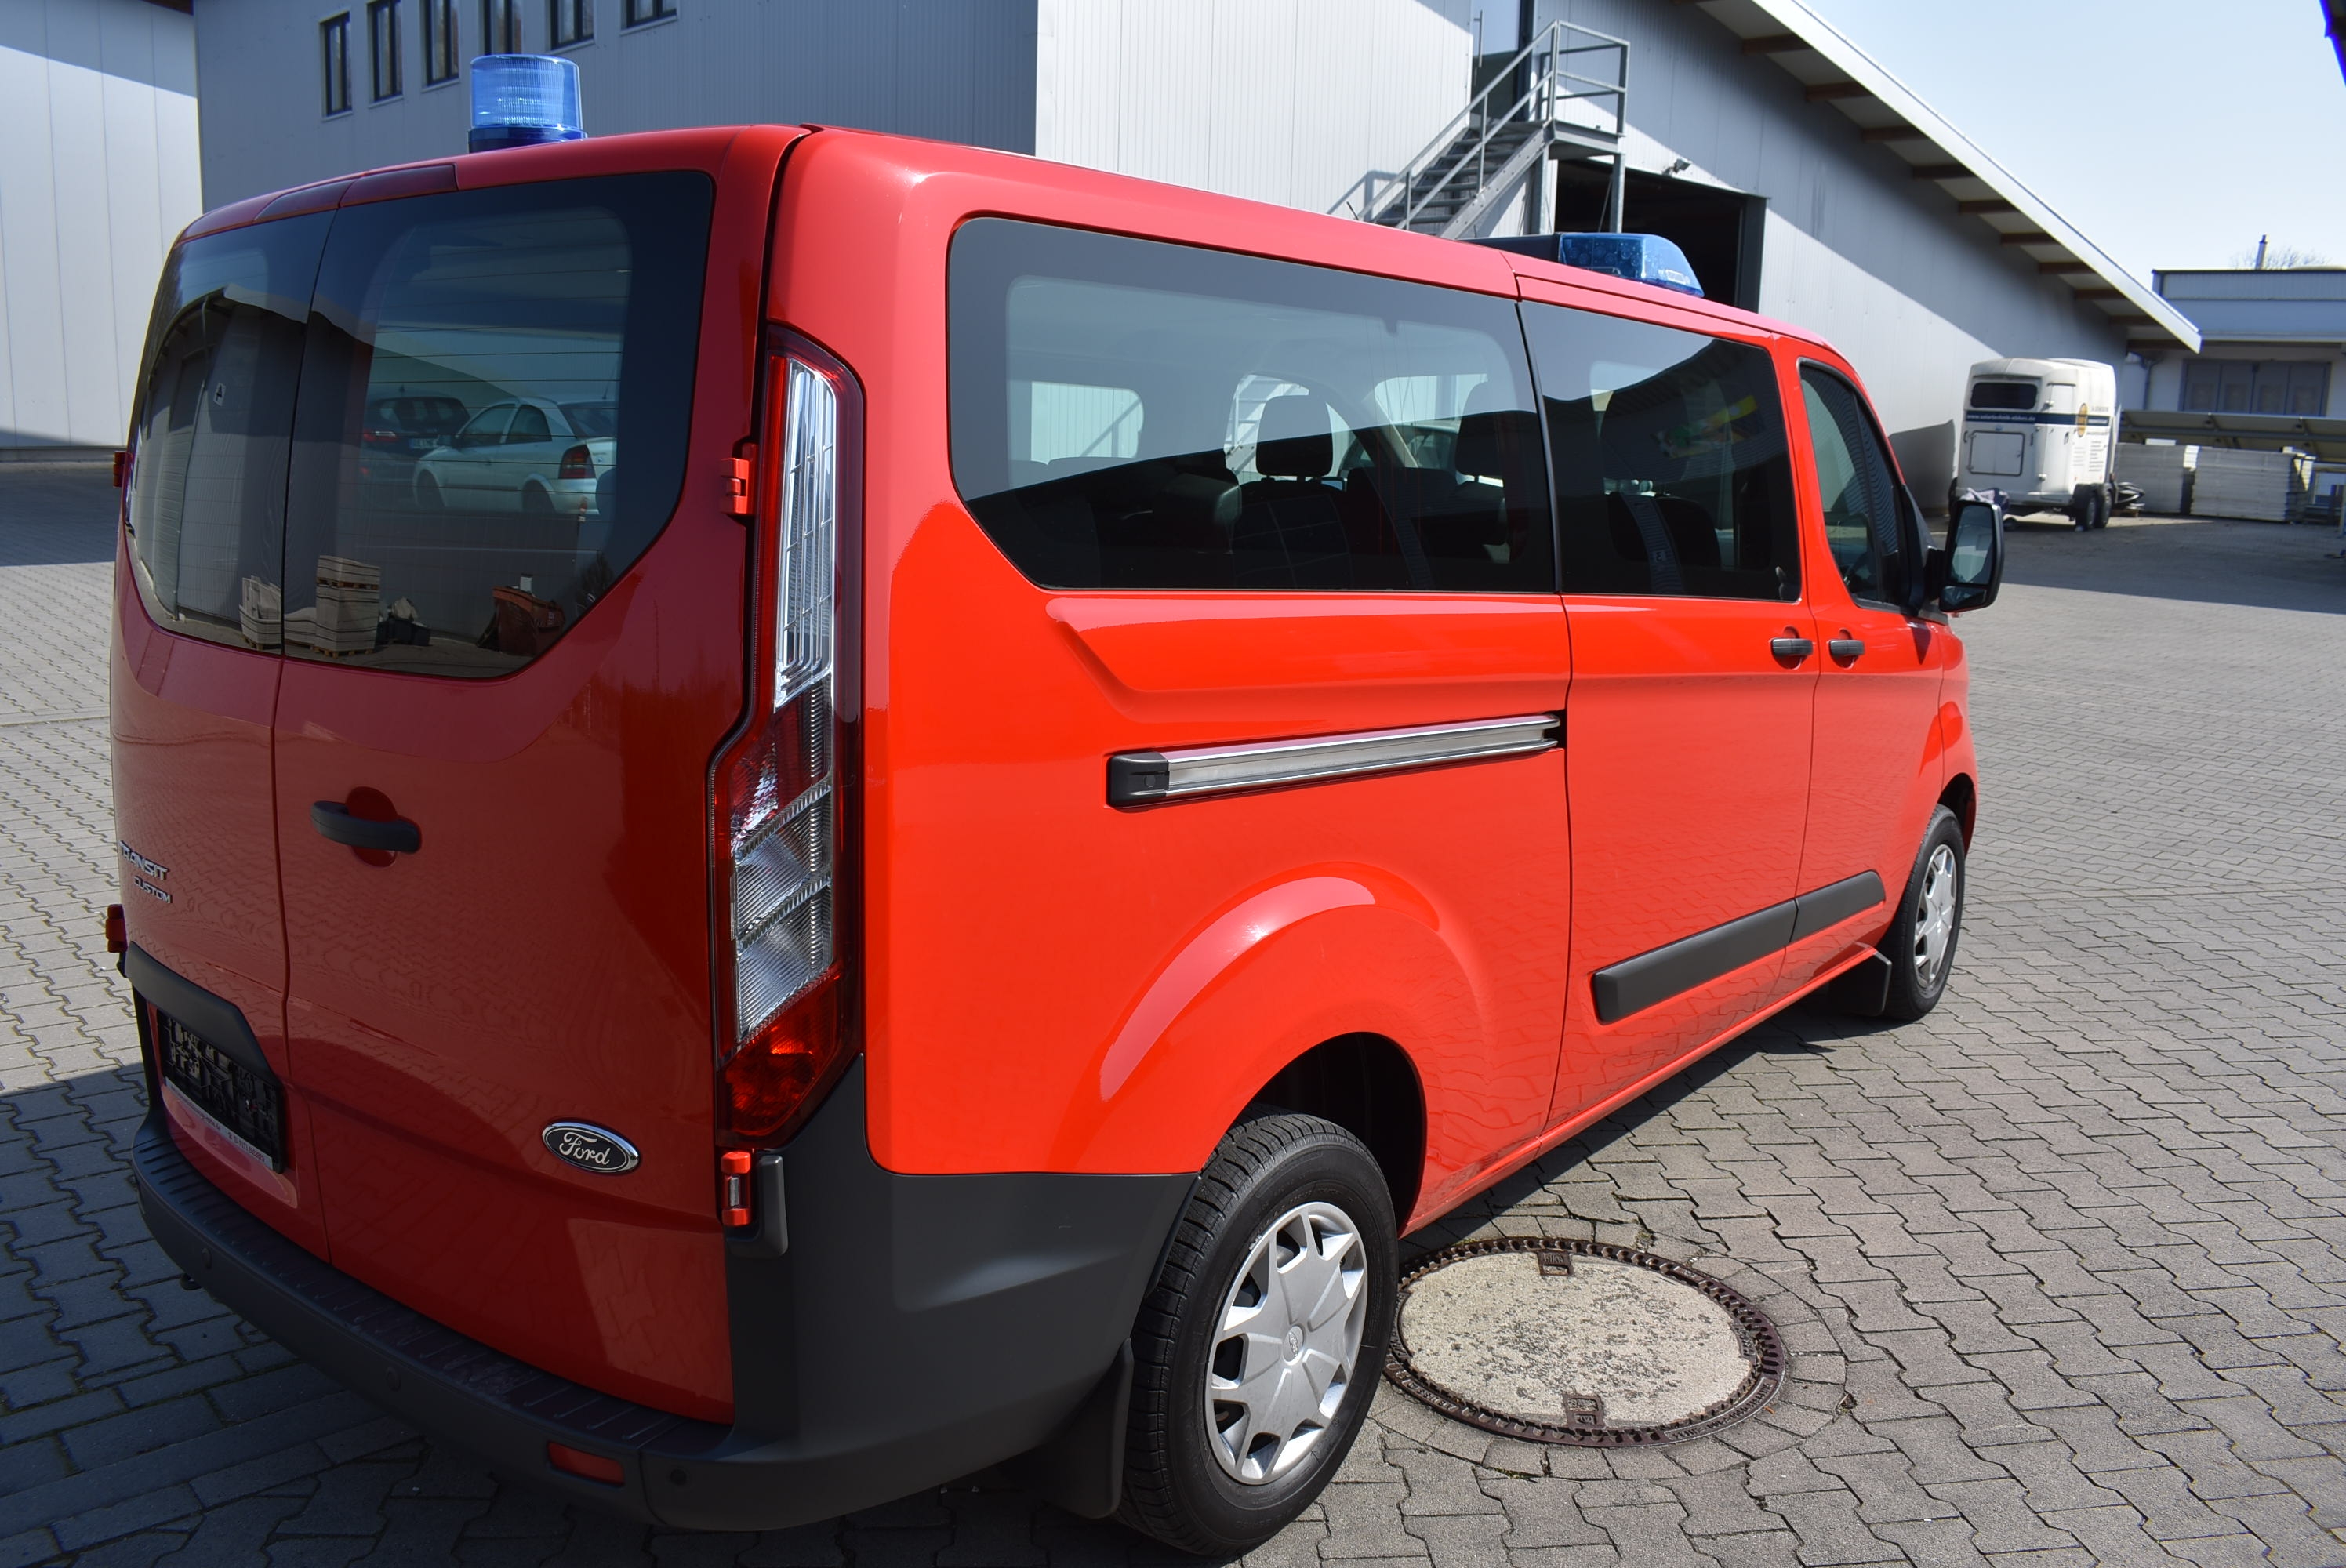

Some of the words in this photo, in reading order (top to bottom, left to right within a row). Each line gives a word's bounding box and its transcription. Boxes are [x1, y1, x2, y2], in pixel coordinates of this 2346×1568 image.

[119, 840, 169, 880] TRANSIT
[133, 875, 172, 903] CUSTOM
[559, 1131, 610, 1166] Ford
